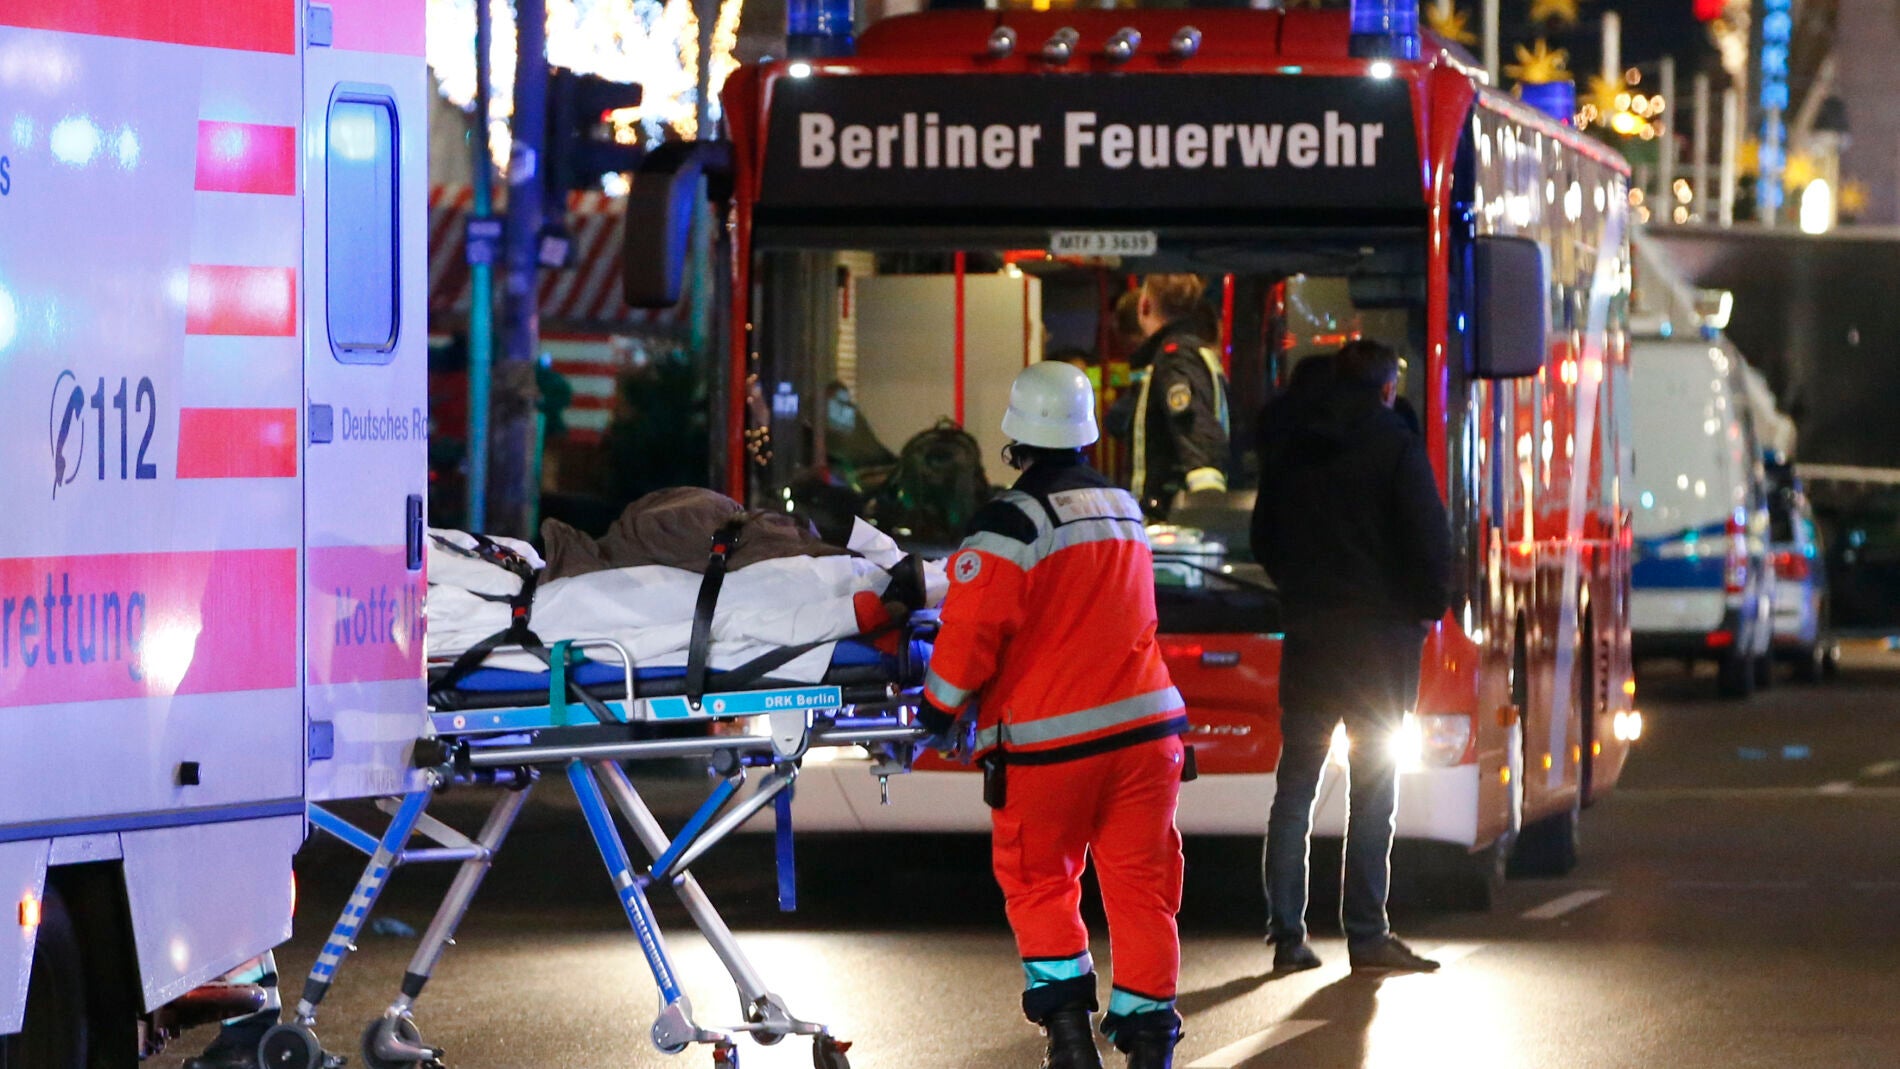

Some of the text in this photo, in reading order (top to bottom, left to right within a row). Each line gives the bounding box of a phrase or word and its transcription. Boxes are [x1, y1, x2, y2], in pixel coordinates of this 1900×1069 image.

[799, 110, 1385, 169] Berliner Feuerwehr
[90, 376, 157, 480] 112
[342, 407, 409, 441] Deutsches
[2, 572, 147, 683] rettung
[765, 693, 836, 708] DRK Berlin
